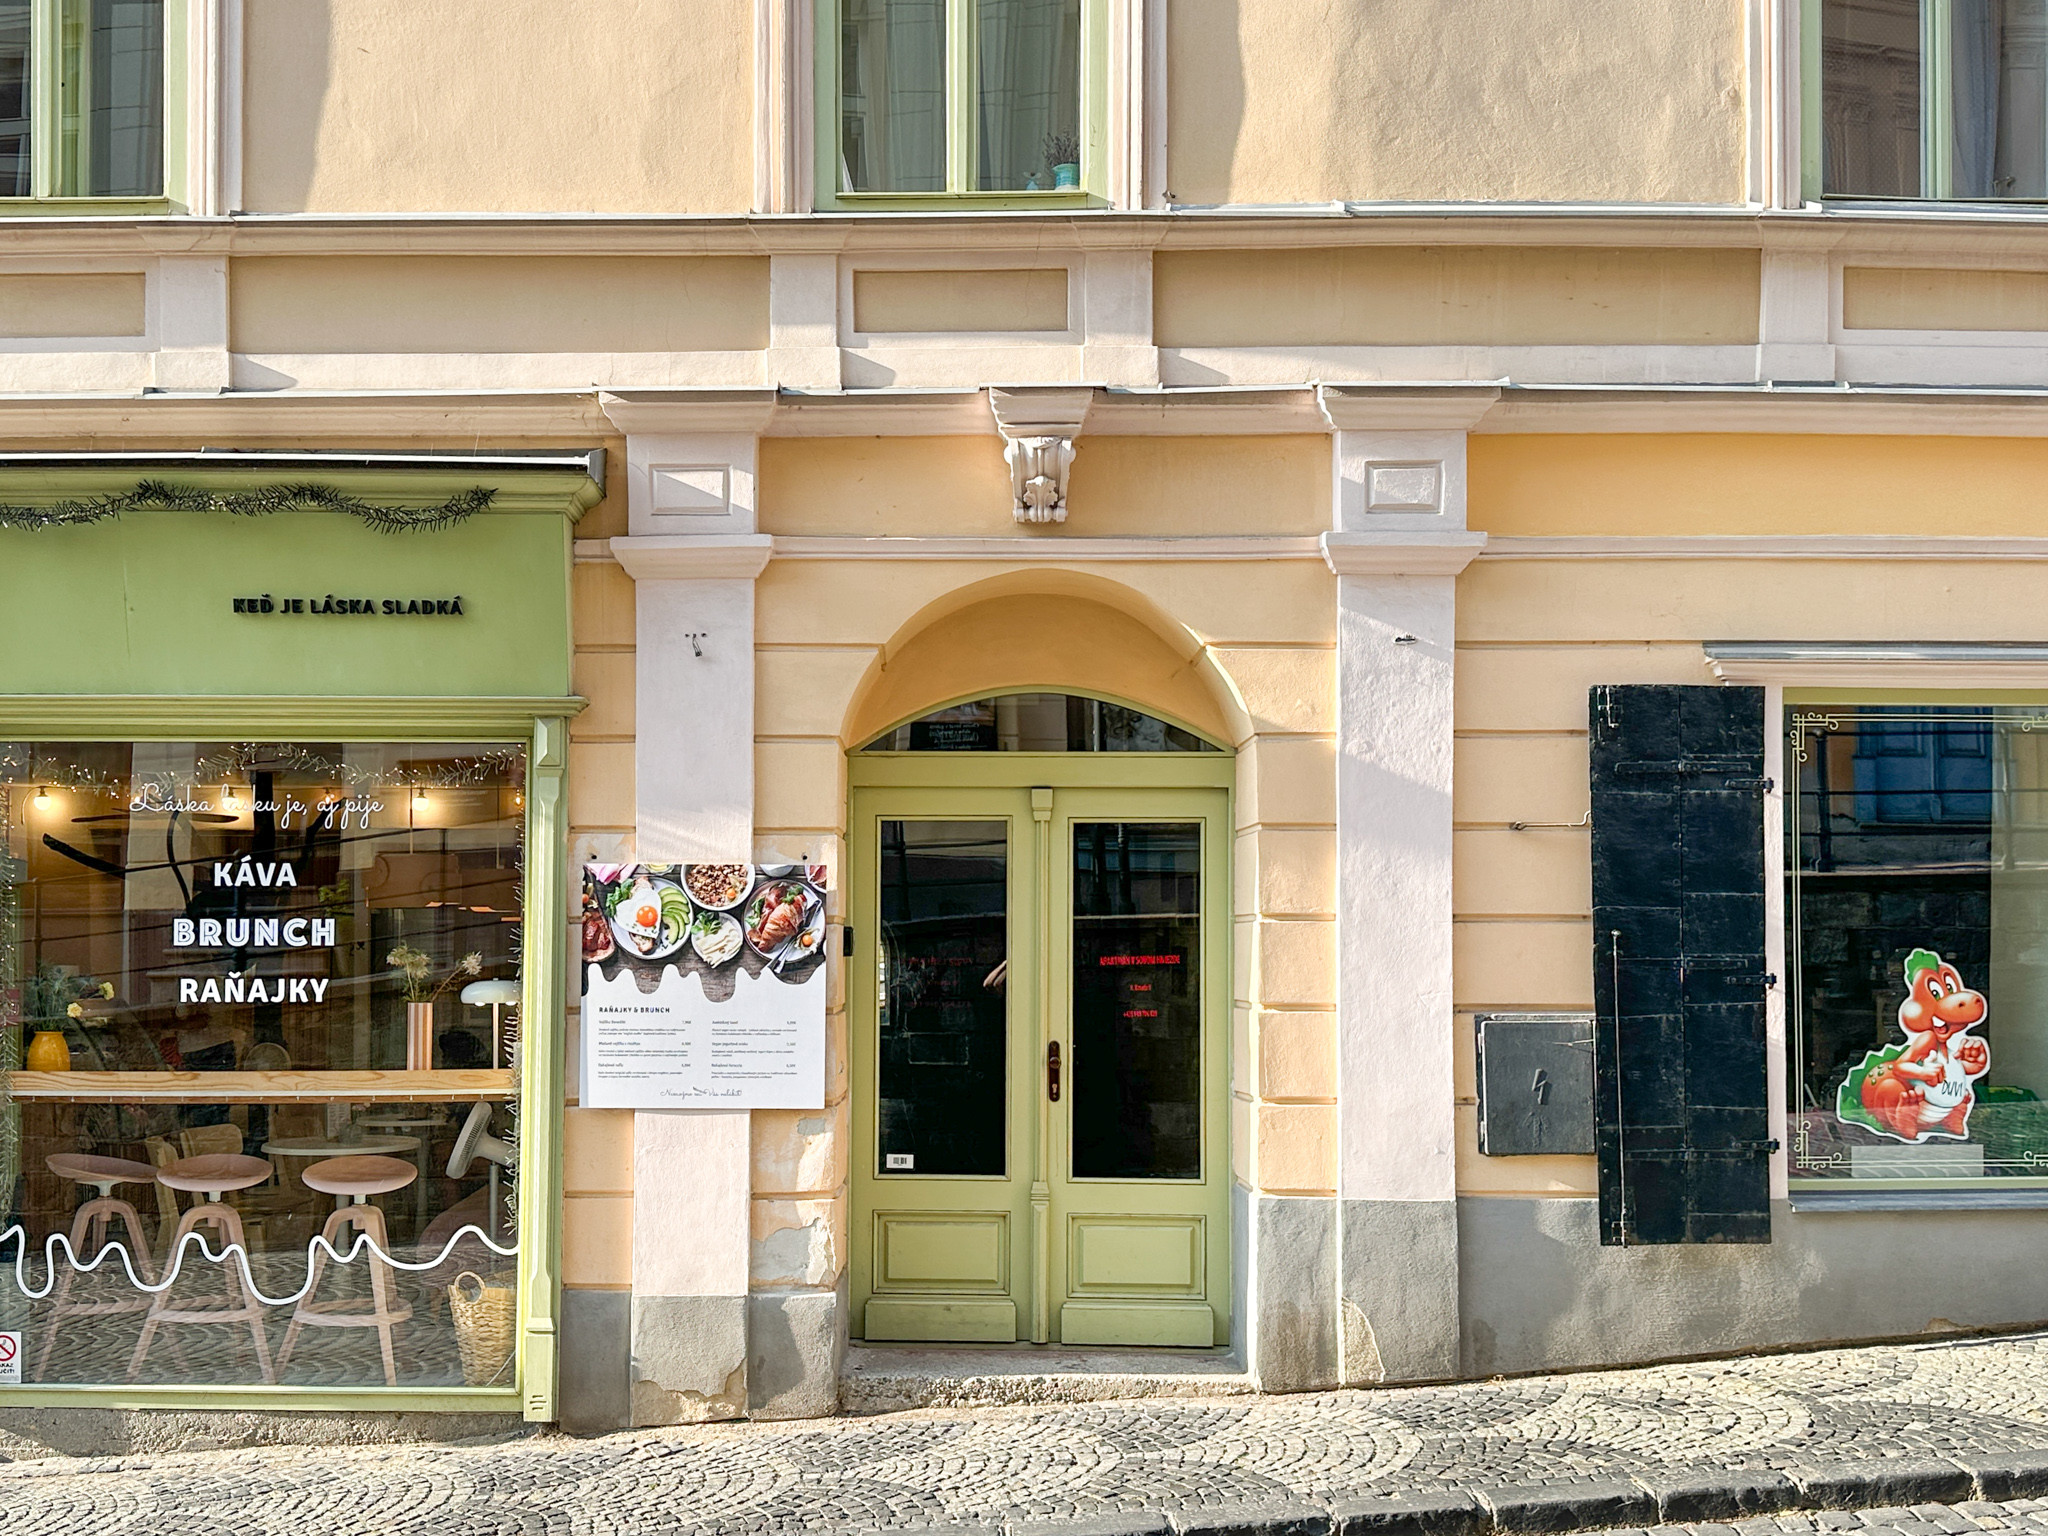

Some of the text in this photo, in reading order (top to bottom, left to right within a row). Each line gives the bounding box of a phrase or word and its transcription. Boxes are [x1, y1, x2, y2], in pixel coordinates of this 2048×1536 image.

[233, 593, 464, 616] KEĎ JE LÁSKA SLADKÁ
[129, 783, 214, 812] Láska
[339, 793, 384, 829] pije
[213, 854, 298, 887] KÁVA
[172, 917, 336, 947] BRUNCH
[179, 970, 330, 1003] RAŇAJKY
[599, 1005, 670, 1014] RAŇAJKY & BRUNCH
